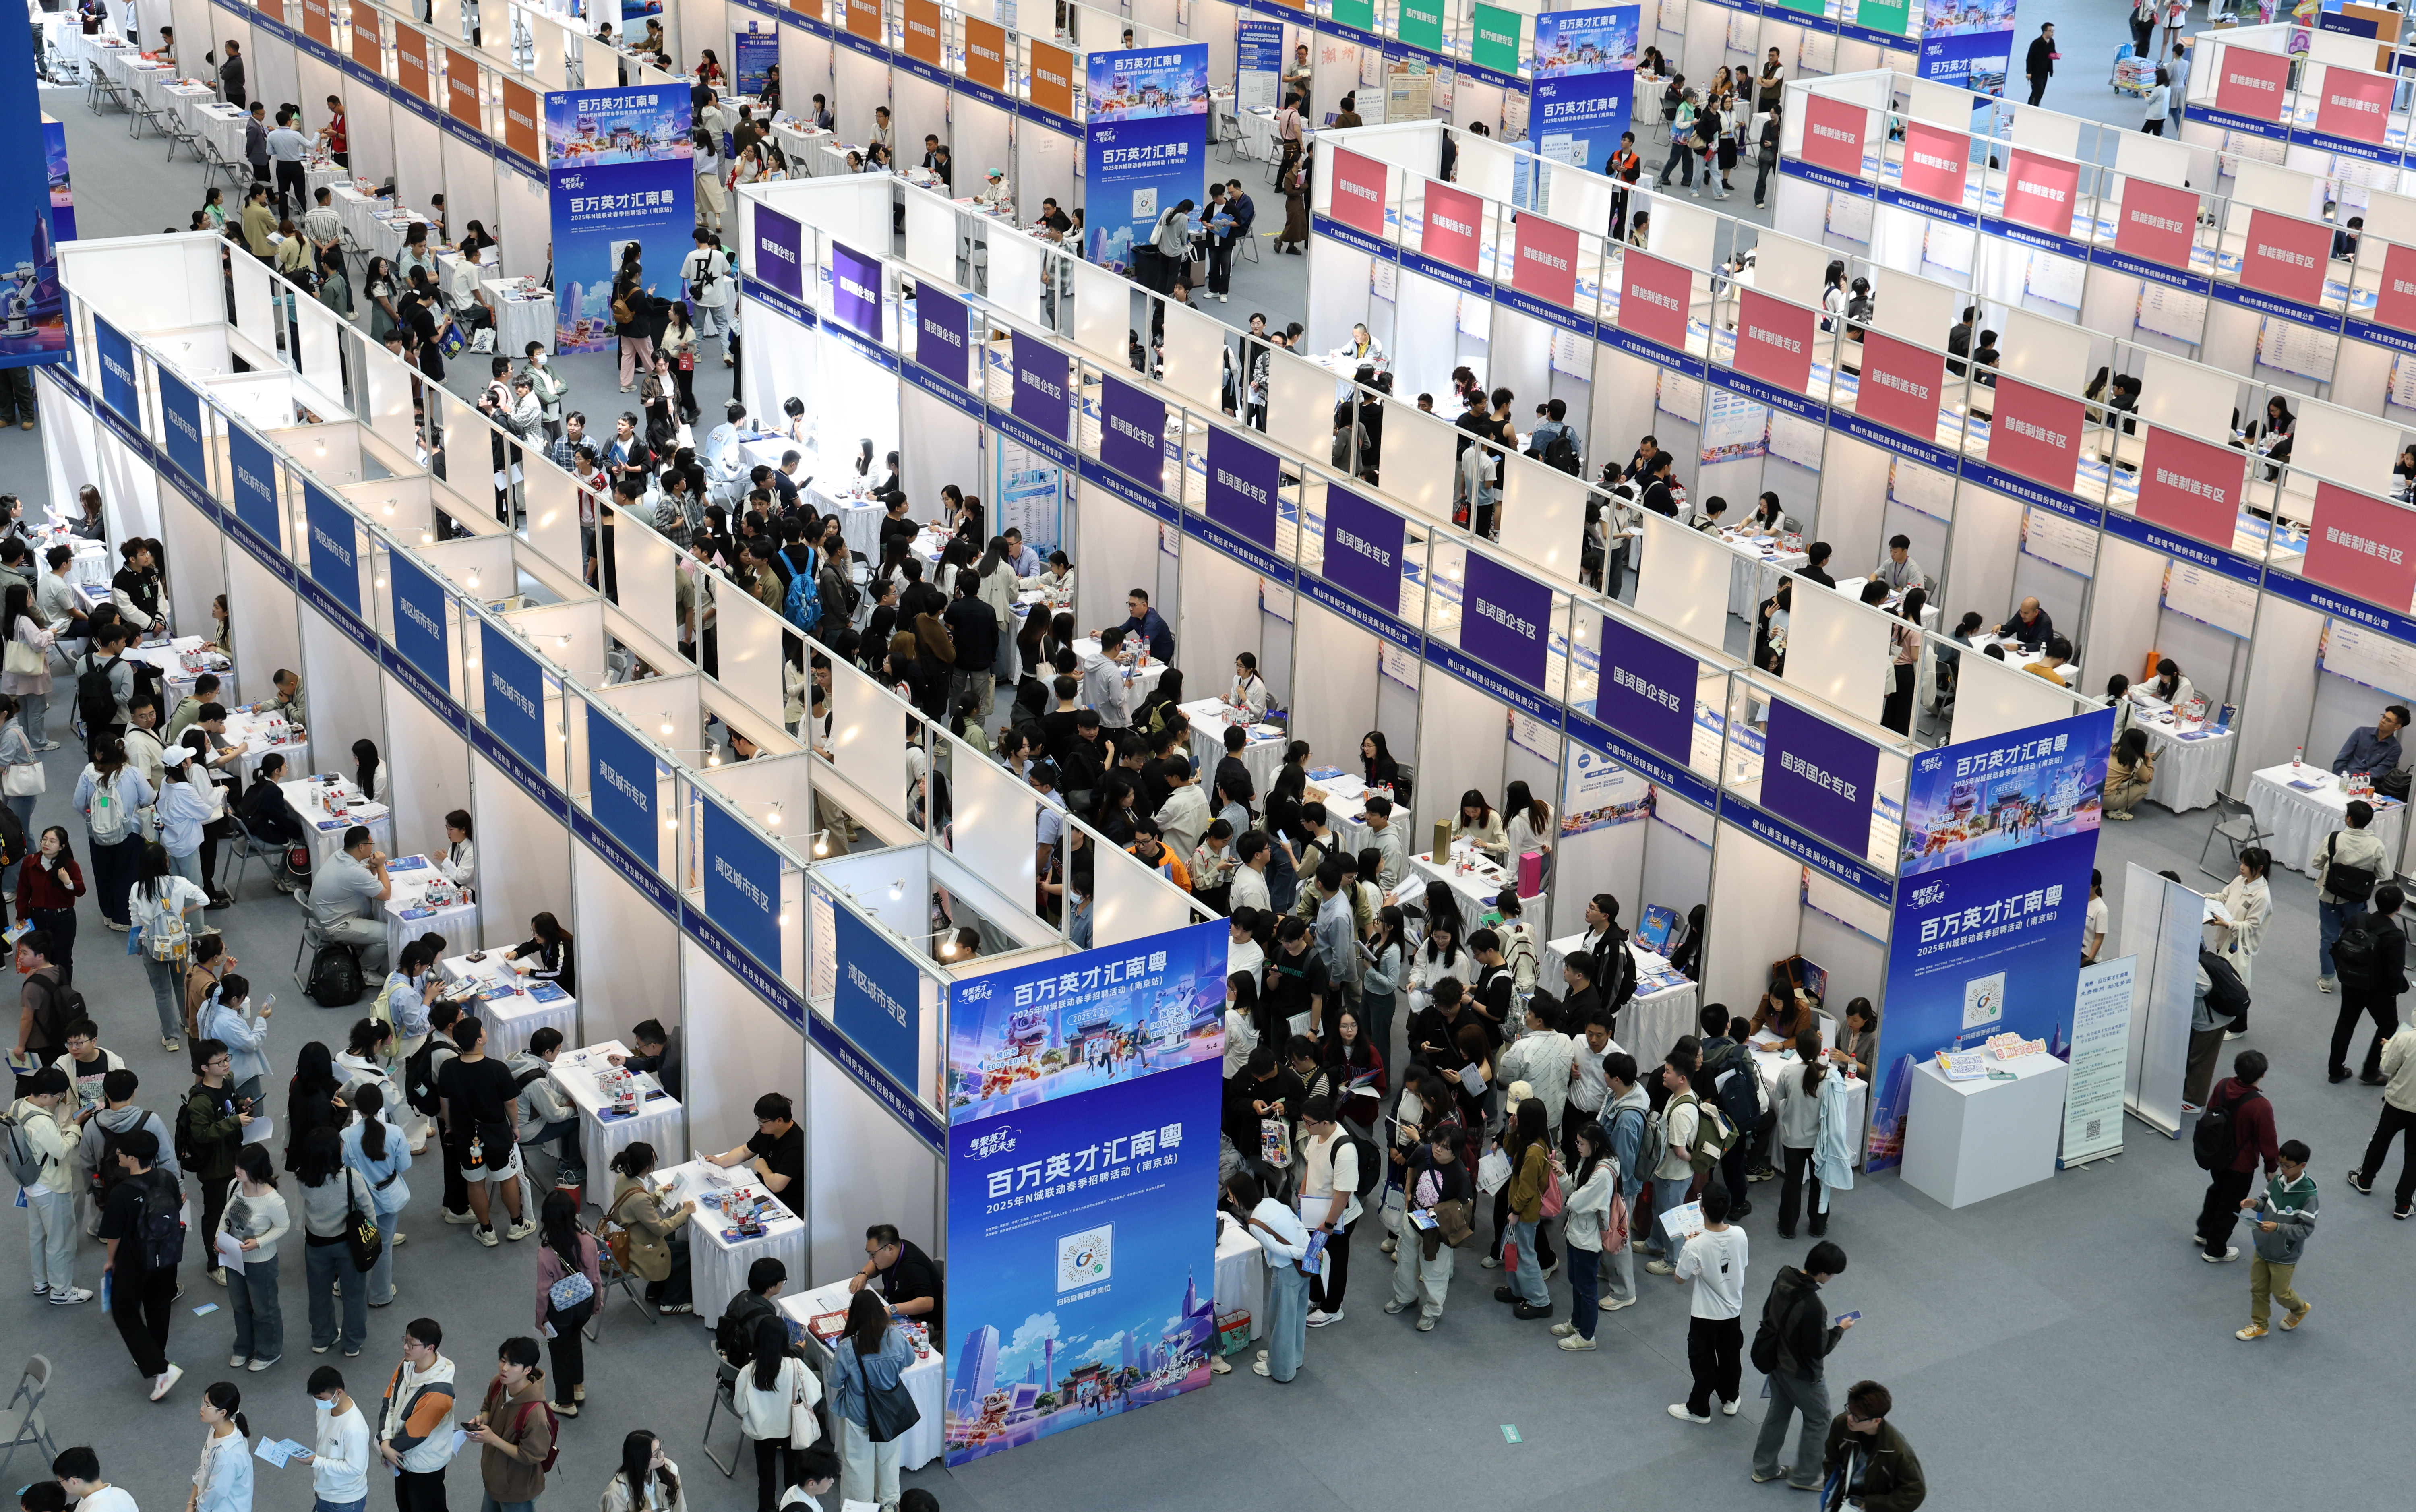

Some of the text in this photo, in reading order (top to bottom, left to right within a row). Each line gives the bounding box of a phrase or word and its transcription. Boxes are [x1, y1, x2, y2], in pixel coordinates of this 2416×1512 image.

[1406, 8, 1437, 25] 医疗健康专区
[1559, 15, 1616, 30] 百万英才汇南粤
[1480, 29, 1513, 47] 医疗健康专区
[971, 44, 999, 62] 教育科研专区
[1114, 54, 1182, 70] 百万英才汇南粤
[451, 78, 475, 99] 教育科研专区
[1036, 68, 1067, 87] 教育科研专区
[578, 95, 658, 112] 百万英才汇南粤
[976, 91, 994, 102] 广州软件学院
[1544, 97, 1618, 117] 百万英才汇南粤
[2331, 94, 2380, 114] 智能制造专区
[508, 108, 534, 130] 教育科研专区
[1814, 124, 1855, 144] 智能制造专区
[1103, 142, 1188, 163] 百万英才汇南粤
[560, 176, 580, 184] 粤聚英才
[1806, 171, 1849, 188] 广东东亚电器有限公司
[570, 190, 674, 213] 百万英才汇南粤
[571, 207, 672, 221] 2025年N城联动春季招聘活动（南京站）
[2006, 230, 2061, 250] 佛山市实达科技有限公司
[1524, 246, 1568, 271] 智能制造专区
[2257, 244, 2315, 269] 智能制造专区
[2112, 259, 2188, 286] 广东申菱环境系统股份有限公司
[1513, 298, 1576, 327] 广东中科安齿生物科技有限公司
[2239, 295, 2314, 322] 佛山市博顿光电科技有限公司
[1749, 325, 1801, 354] 智能制造专区
[1622, 339, 1680, 367] 广东星联精密机械有限公司
[1021, 368, 1061, 400] 国资国企专区
[1729, 379, 1804, 412] 航天柏克（广东）科技有限公司
[1002, 421, 1063, 461] 佛山市三水区国有资产监督管理局
[1850, 424, 1937, 462] 佛山市高明区新粤丰建材有限公司
[2005, 416, 2067, 449] 智能制造专区
[238, 464, 271, 503] 湾区城市专区
[1102, 475, 1157, 511] 广东南海产业集团有限公司
[1987, 476, 2075, 514] 广东赛普智能制造股份有限公司
[2157, 467, 2225, 503] 智能制造专区
[1203, 530, 1274, 573] 广东南海资产经营管理有限公司
[1336, 527, 1390, 567] 国资国企专区
[2147, 534, 2217, 566] 胜业电气股份有限公司
[2326, 526, 2404, 565] 智能制造专区
[400, 596, 440, 641] 湾区城市专区
[1313, 587, 1407, 643] 佛山市高明交通建设投资集团有限公司
[1476, 597, 1536, 640] 国资国企专区
[2311, 594, 2389, 629] 顺特电气设备有限公司
[492, 671, 536, 720] 湾区城市专区
[1448, 658, 1540, 713] 佛山市高明建设投资集团有限公司
[1614, 666, 1680, 713] 国资国企专区
[1606, 742, 1674, 784] 中国中药控股有限公司
[1956, 734, 2068, 777] 百万英才汇南粤
[492, 747, 546, 800] 南宝树脂（佛山）有限公司
[1781, 750, 1857, 802] 国资国企专区
[1953, 756, 2063, 788] 2025年N城联动春季招聘活动（南京站）
[600, 759, 647, 813] 湾区城市专区
[1995, 782, 2021, 793] 2025.4.26
[2049, 790, 2079, 802] C061-C064
[2057, 783, 2073, 792] 展位号
[2048, 798, 2079, 810] D001-D006
[1930, 819, 1960, 833] D007-D016
[1937, 813, 1954, 823] 展位号
[1752, 819, 1860, 883] 佛山通宝精密合金股份有限公司
[592, 831, 660, 899] 深圳开鸿数字产业发展有限公司
[715, 854, 769, 914] 湾区城市专区
[1912, 883, 1940, 899] 粤聚英才
[1879, 893, 1889, 901] D016
[1917, 891, 1945, 907] 粤见未来
[1920, 884, 2063, 943] 百万英才汇南粤
[1917, 910, 2057, 957] 2025年N城联动春季招聘活动（南京站）
[699, 925, 788, 1010] 瑞声开泰（深圳）科技发展有限公司
[1013, 951, 1167, 1007] 百万英才汇南粤
[848, 961, 906, 1028] 湾区城市专区
[962, 983, 987, 997] 粤聚英才
[967, 989, 993, 1003] 粤见未来
[1012, 976, 1163, 1020] 2025年N城联动春季招聘活动（南京站）
[1073, 1008, 1109, 1022] 2025.4.26
[1150, 1014, 1191, 1030] D017-D023
[1160, 1006, 1182, 1019] 展位号
[1151, 1023, 1190, 1038] E001-E003
[1961, 1025, 2001, 1041] 扫码查看更多岗位
[995, 1047, 1018, 1060] 展位号
[1206, 1042, 1217, 1050] 5.4
[986, 1055, 1028, 1071] E006-E015
[1951, 1056, 1982, 1065] 免费梅州
[1952, 1064, 1983, 1074] 助您梦圆
[839, 1047, 914, 1123] 深圳京发科技控股有限公司
[936, 1142, 944, 1152] E015
[969, 1129, 1008, 1151] 粤聚英才
[978, 1138, 1016, 1158] 粤见未来
[987, 1122, 1183, 1199] 百万英才汇南粤
[986, 1153, 1178, 1214] 2025年N城联动春季招聘活动（南京站）
[1146, 1184, 1165, 1192] 佛山市人民政府
[1031, 1210, 1051, 1219] 广东省人民政府
[1056, 1284, 1111, 1307] 扫码查看更多岗位
[1149, 1350, 1194, 1382] 功夫传天下
